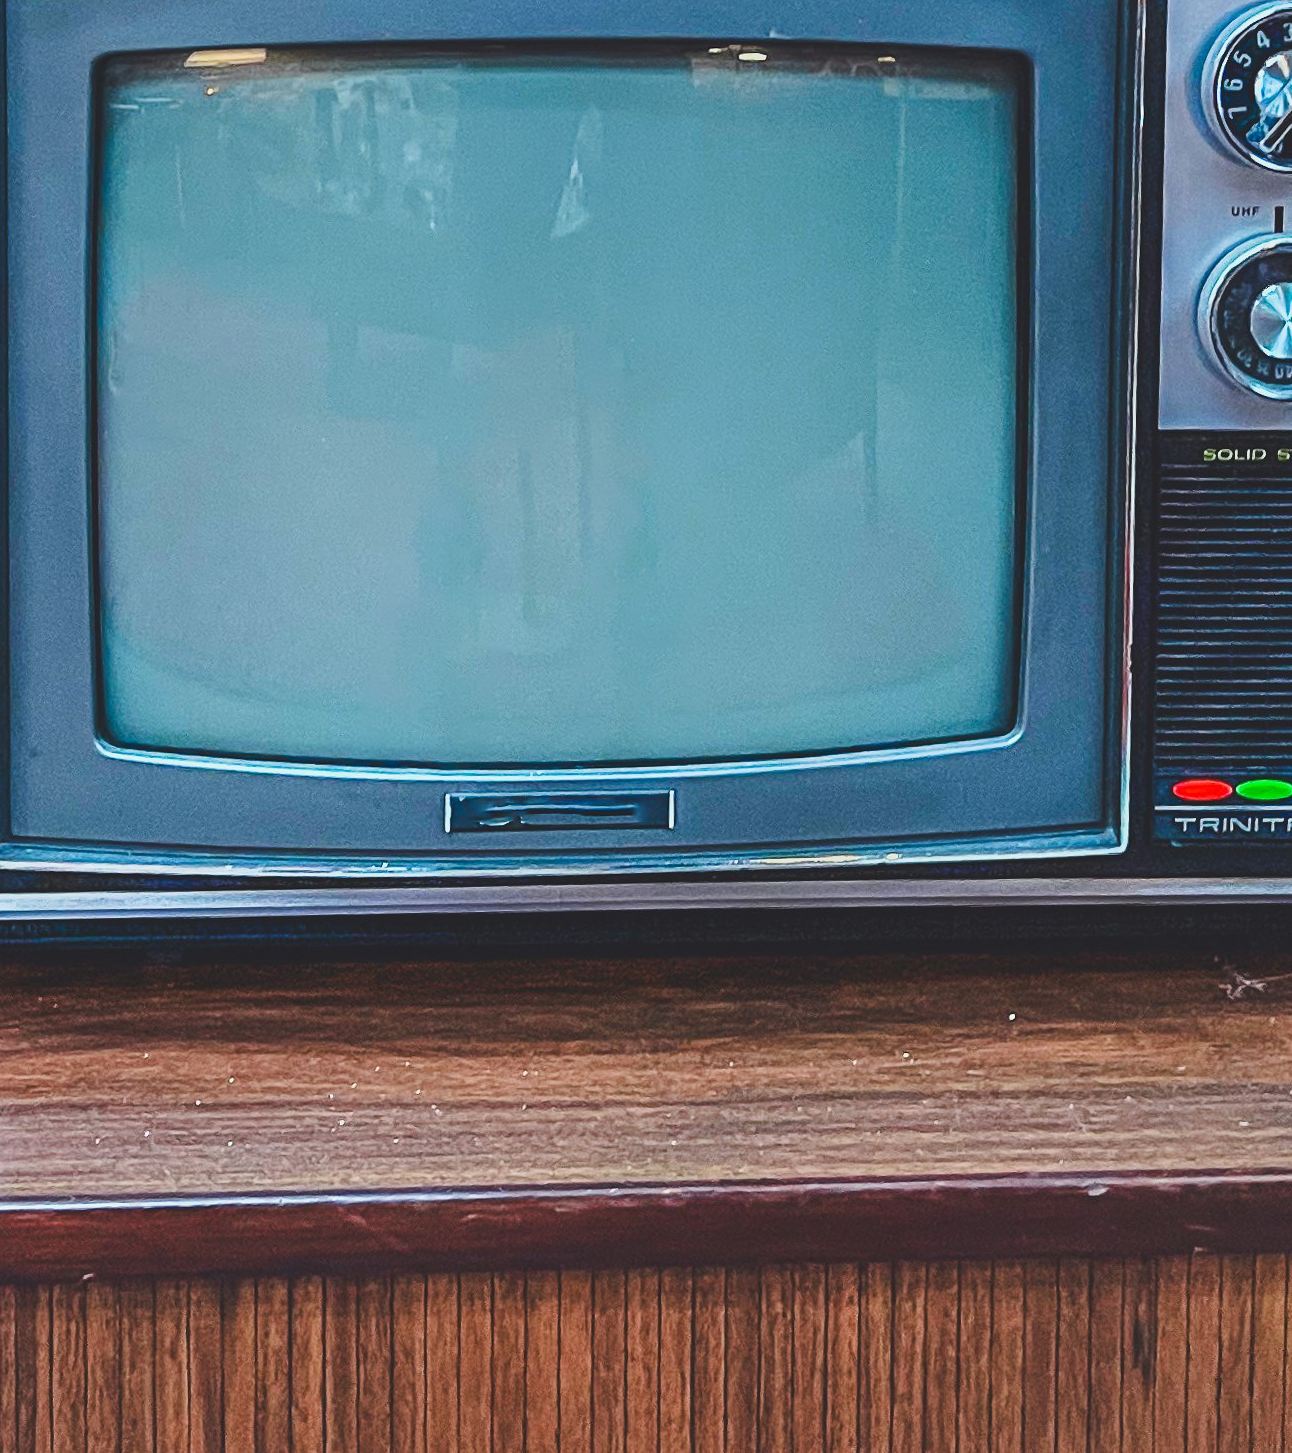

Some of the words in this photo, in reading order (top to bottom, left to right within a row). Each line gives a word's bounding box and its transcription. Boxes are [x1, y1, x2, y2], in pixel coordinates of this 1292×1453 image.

[1257, 31, 1271, 48] 4
[1233, 50, 1252, 68] 5
[1230, 205, 1260, 217] UHF
[1203, 448, 1267, 462] SOLID
